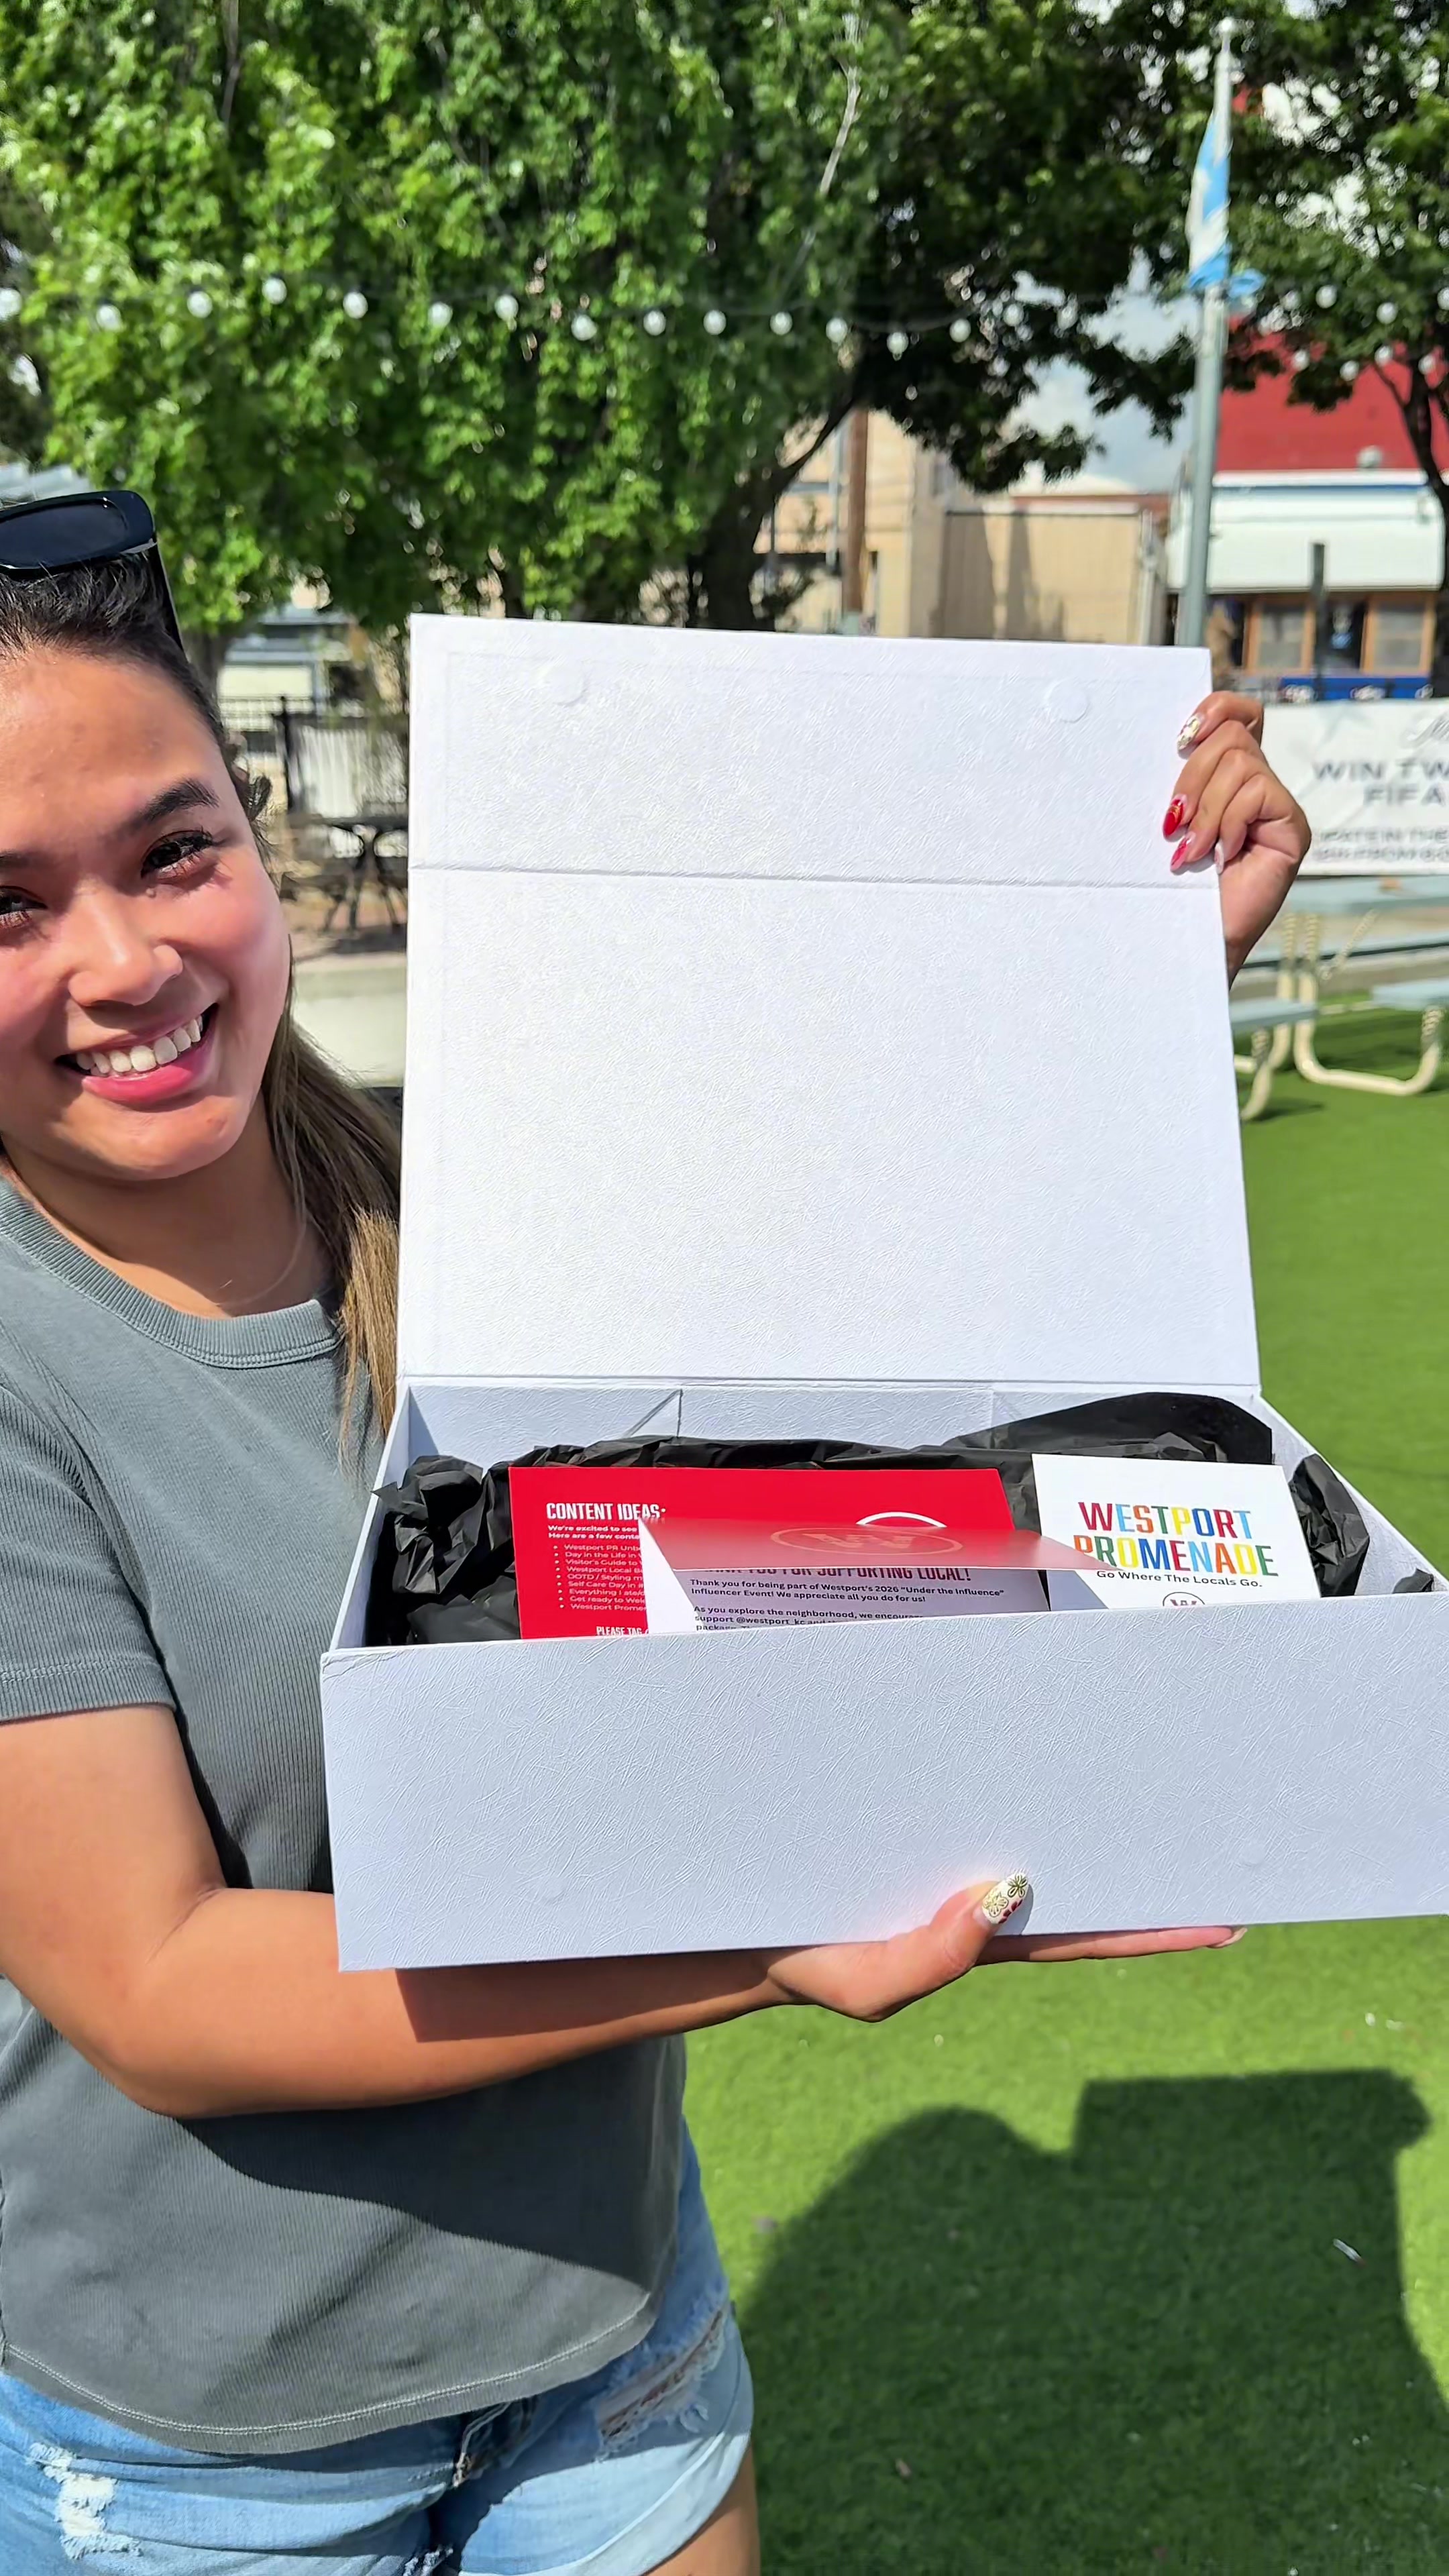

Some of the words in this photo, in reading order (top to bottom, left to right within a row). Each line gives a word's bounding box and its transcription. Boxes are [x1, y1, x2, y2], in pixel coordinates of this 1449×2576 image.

[1312, 760, 1387, 781] WIN
[1364, 783, 1447, 806] FIFA
[546, 1503, 613, 1520] CONTENT
[1078, 1502, 1252, 1539] WESTPORT
[1073, 1535, 1279, 1576] PROMENADE
[917, 1568, 971, 1581] LOCAL!
[1096, 1570, 1115, 1578] Go
[1118, 1572, 1161, 1582] Where
[1164, 1574, 1189, 1583] The
[1193, 1576, 1237, 1587] Locals
[1240, 1578, 1263, 1587] Go.
[691, 1588, 741, 1596] Influencer
[758, 1582, 785, 1590] being
[821, 1584, 873, 1592] Westport's
[786, 1610, 857, 1619] neighborhood,
[596, 1626, 625, 1635] PLEASE
[627, 1627, 642, 1635] TAG
